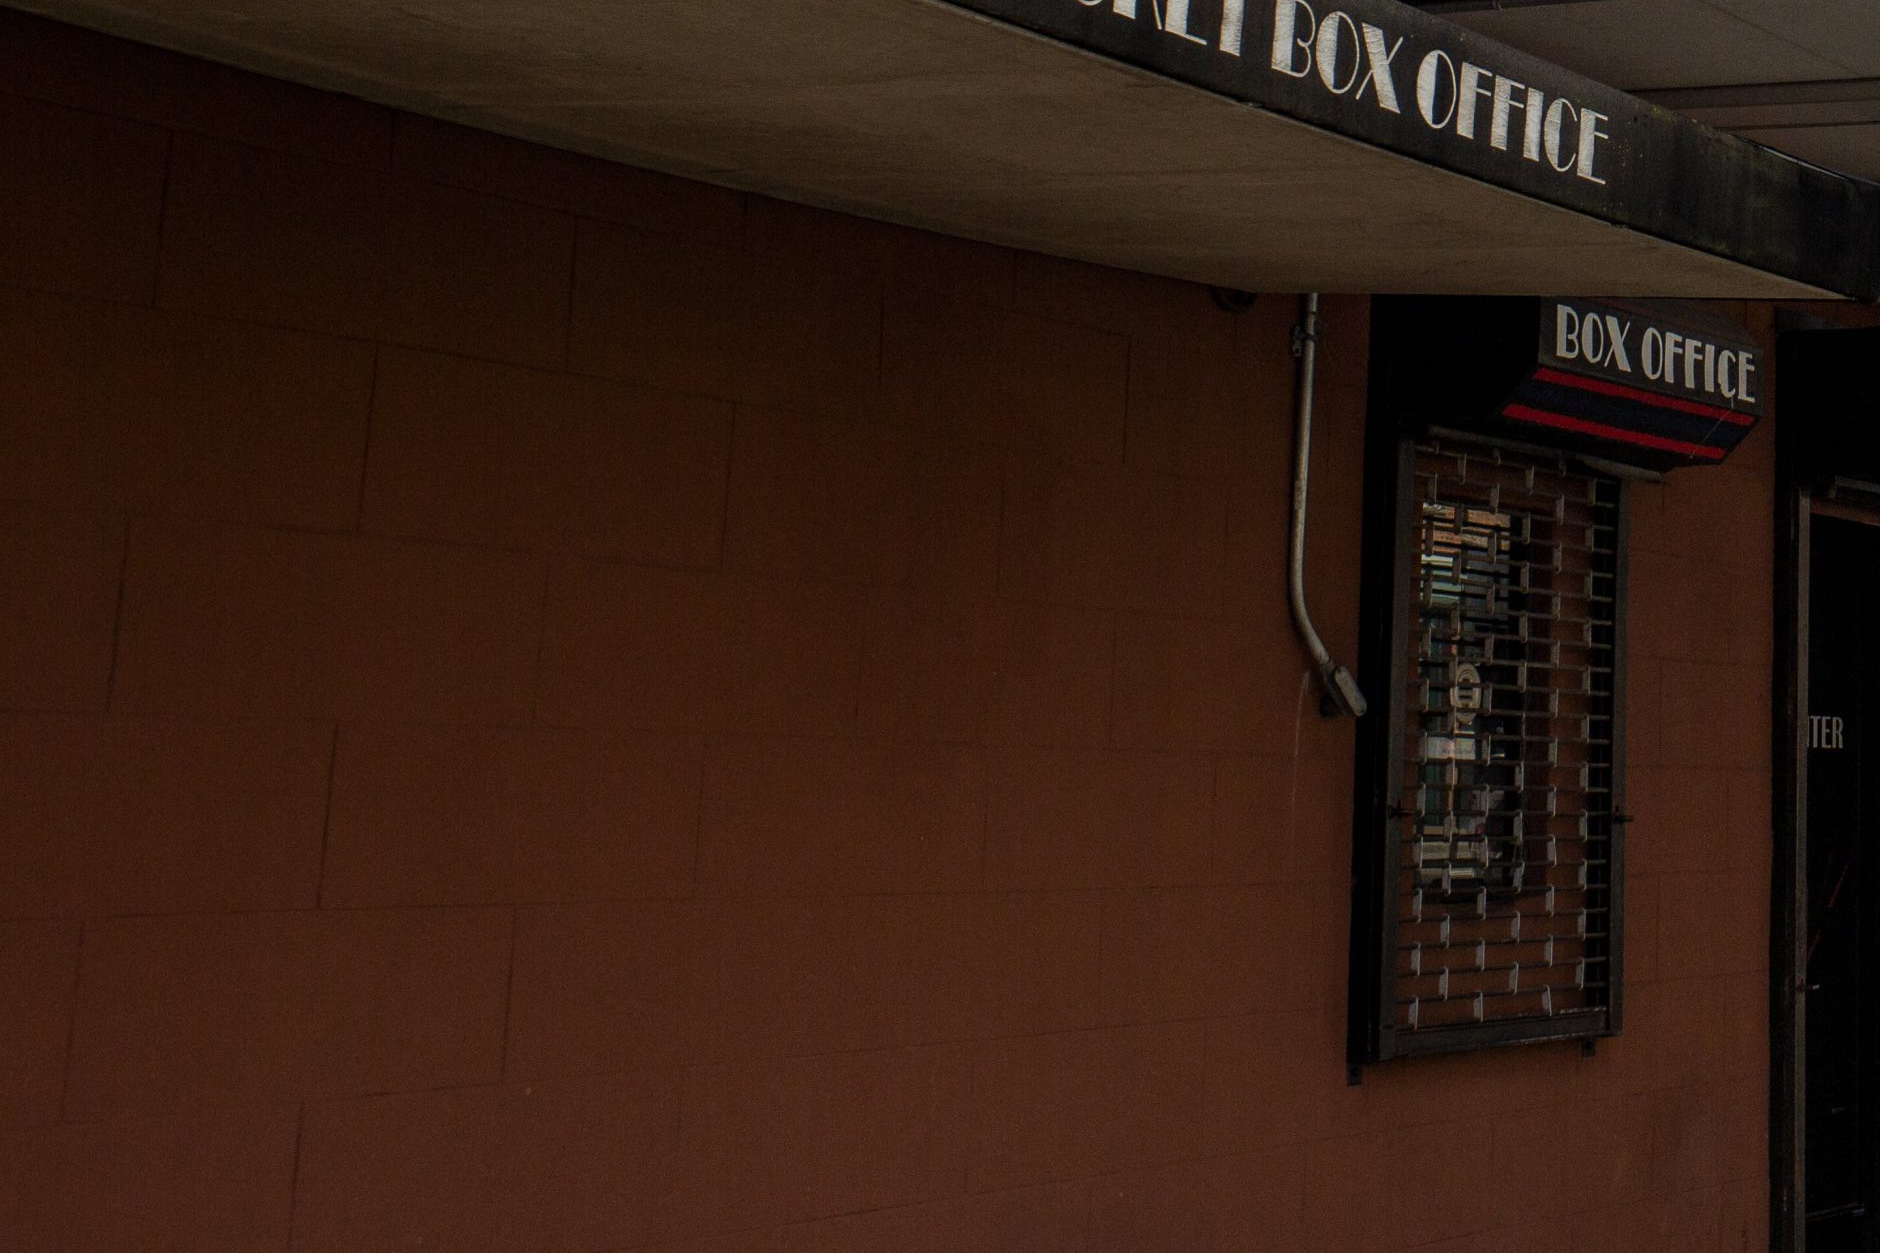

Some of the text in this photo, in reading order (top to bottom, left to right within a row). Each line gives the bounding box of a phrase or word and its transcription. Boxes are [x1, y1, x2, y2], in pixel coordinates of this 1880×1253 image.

[1417, 50, 1608, 184] OFFICE
[1557, 305, 1755, 402] BOX OFFICE
[1807, 716, 1843, 748] TER
